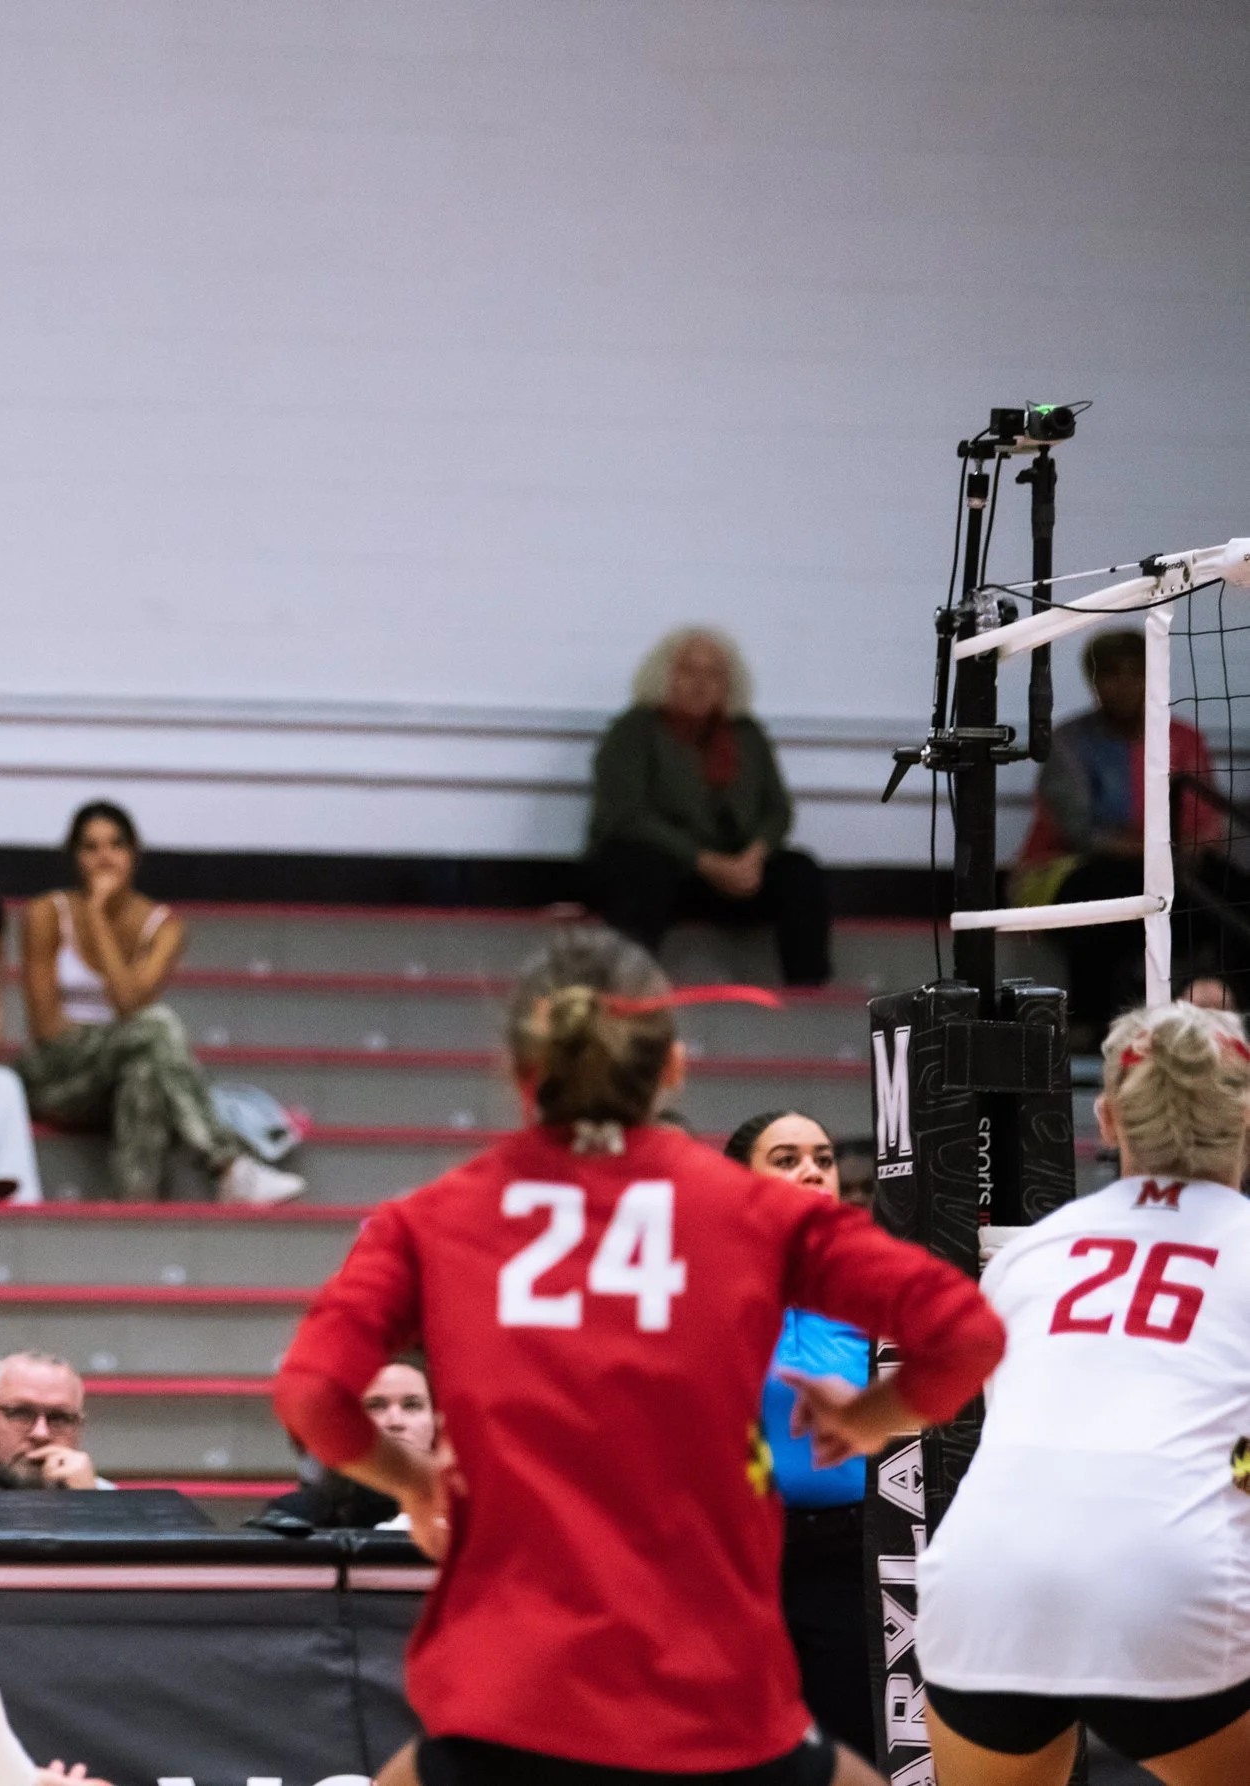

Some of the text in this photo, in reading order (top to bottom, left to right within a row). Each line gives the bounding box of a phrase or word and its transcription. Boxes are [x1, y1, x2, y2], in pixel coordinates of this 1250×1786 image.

[872, 1025, 913, 1160] M
[1130, 1179, 1188, 1212] M
[498, 1180, 687, 1333] 24
[1048, 1237, 1219, 1345] 26
